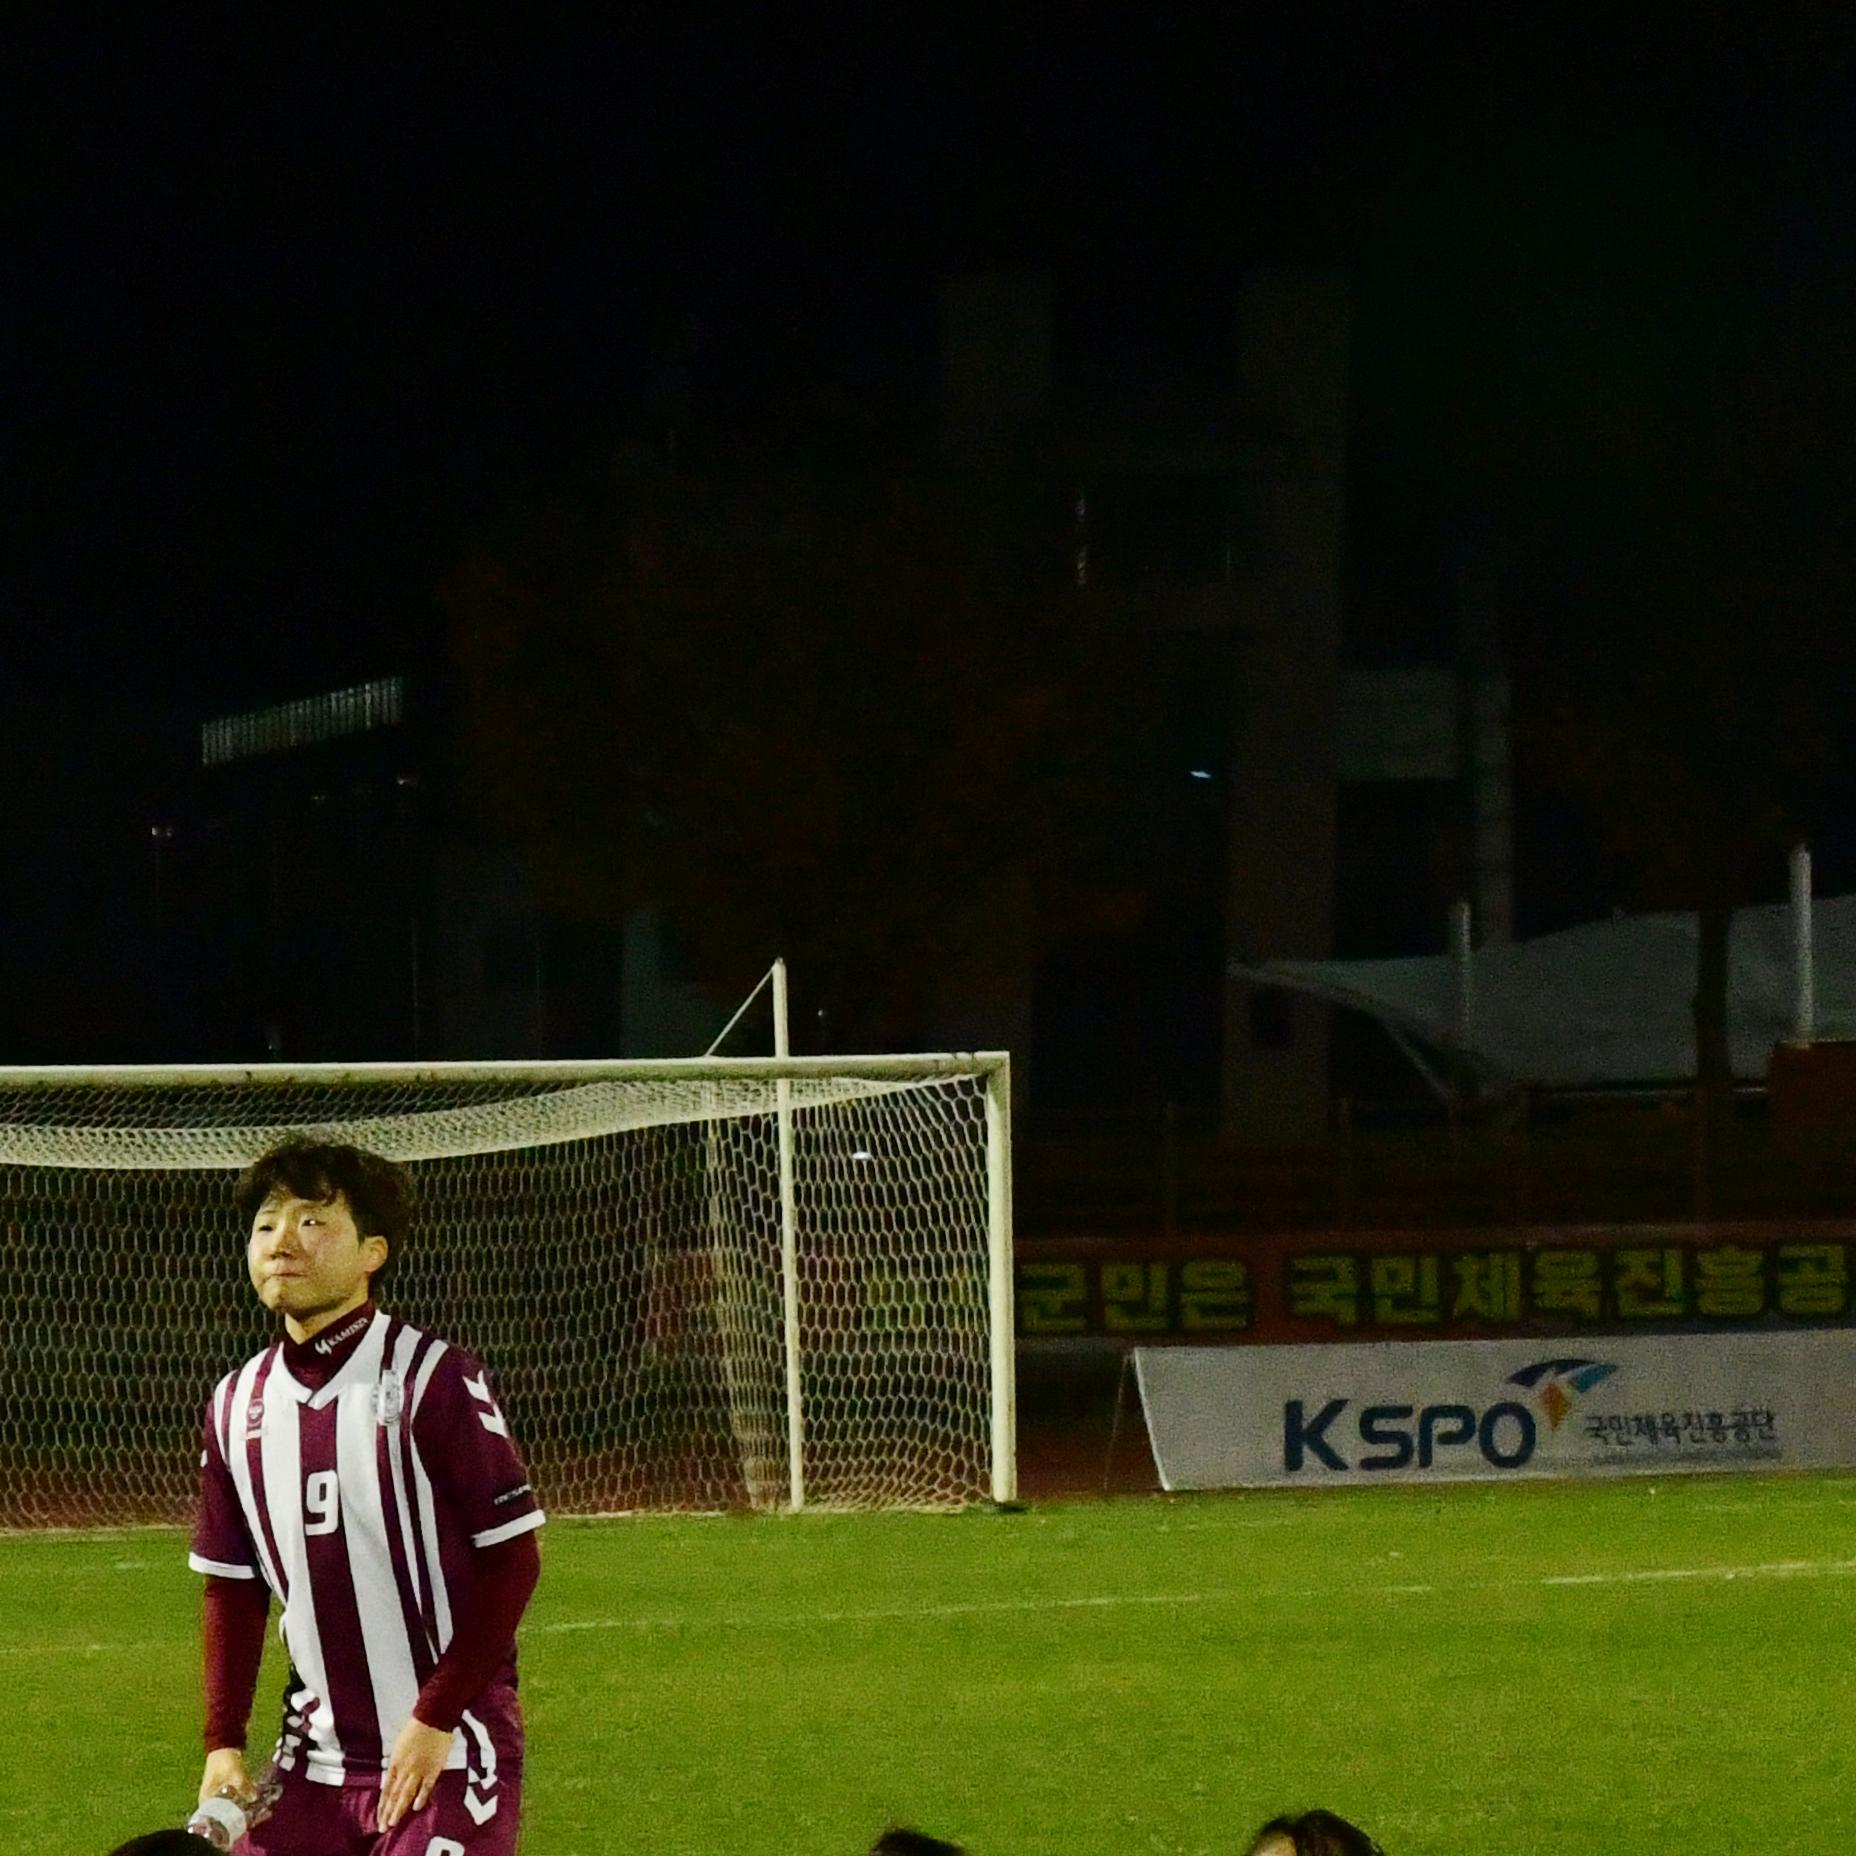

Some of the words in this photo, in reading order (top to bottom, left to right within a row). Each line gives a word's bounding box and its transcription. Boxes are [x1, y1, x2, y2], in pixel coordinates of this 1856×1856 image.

[1285, 1399, 1536, 1471] KSPO
[1585, 1409, 1775, 1446] 국민체육진흥공단
[305, 1469, 339, 1537] 9
